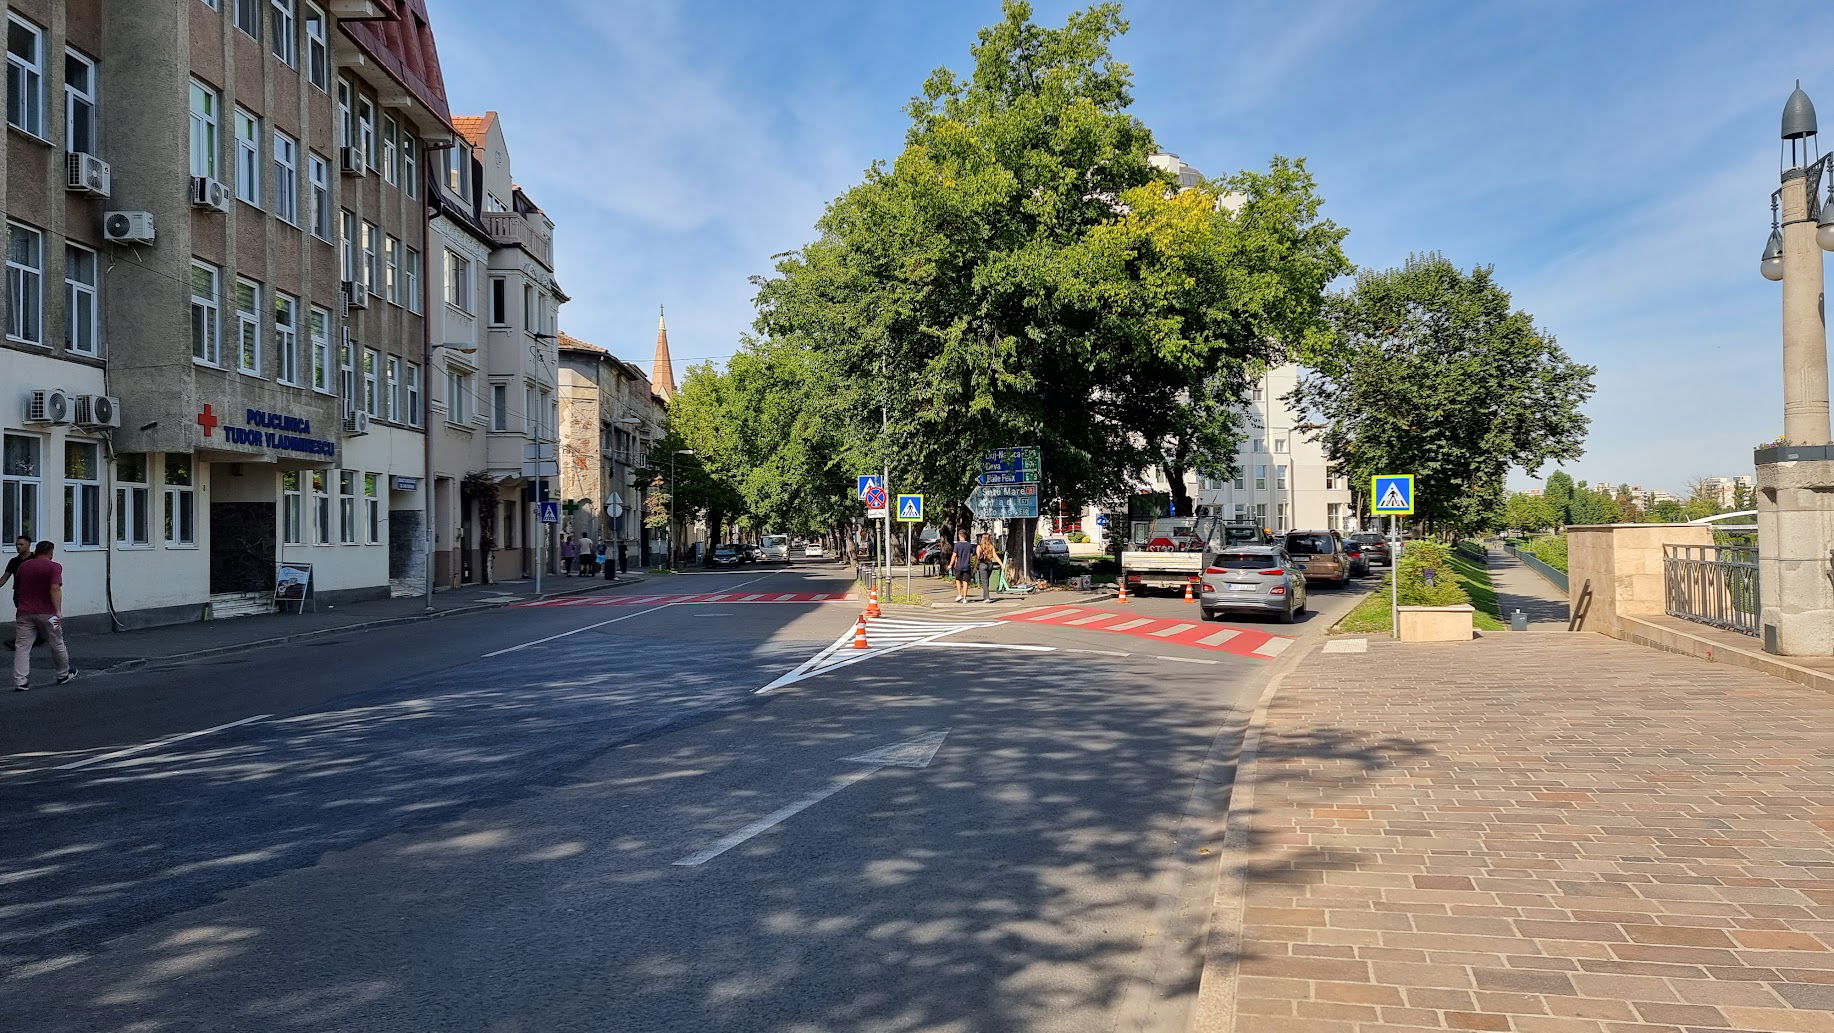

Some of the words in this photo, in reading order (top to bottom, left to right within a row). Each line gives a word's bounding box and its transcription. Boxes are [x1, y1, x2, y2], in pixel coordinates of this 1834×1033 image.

[246, 408, 311, 434] POLICLINICA
[223, 426, 263, 447] TUDOR
[265, 432, 335, 456] VLADIMIRESCU
[1003, 488, 1025, 496] Mare
